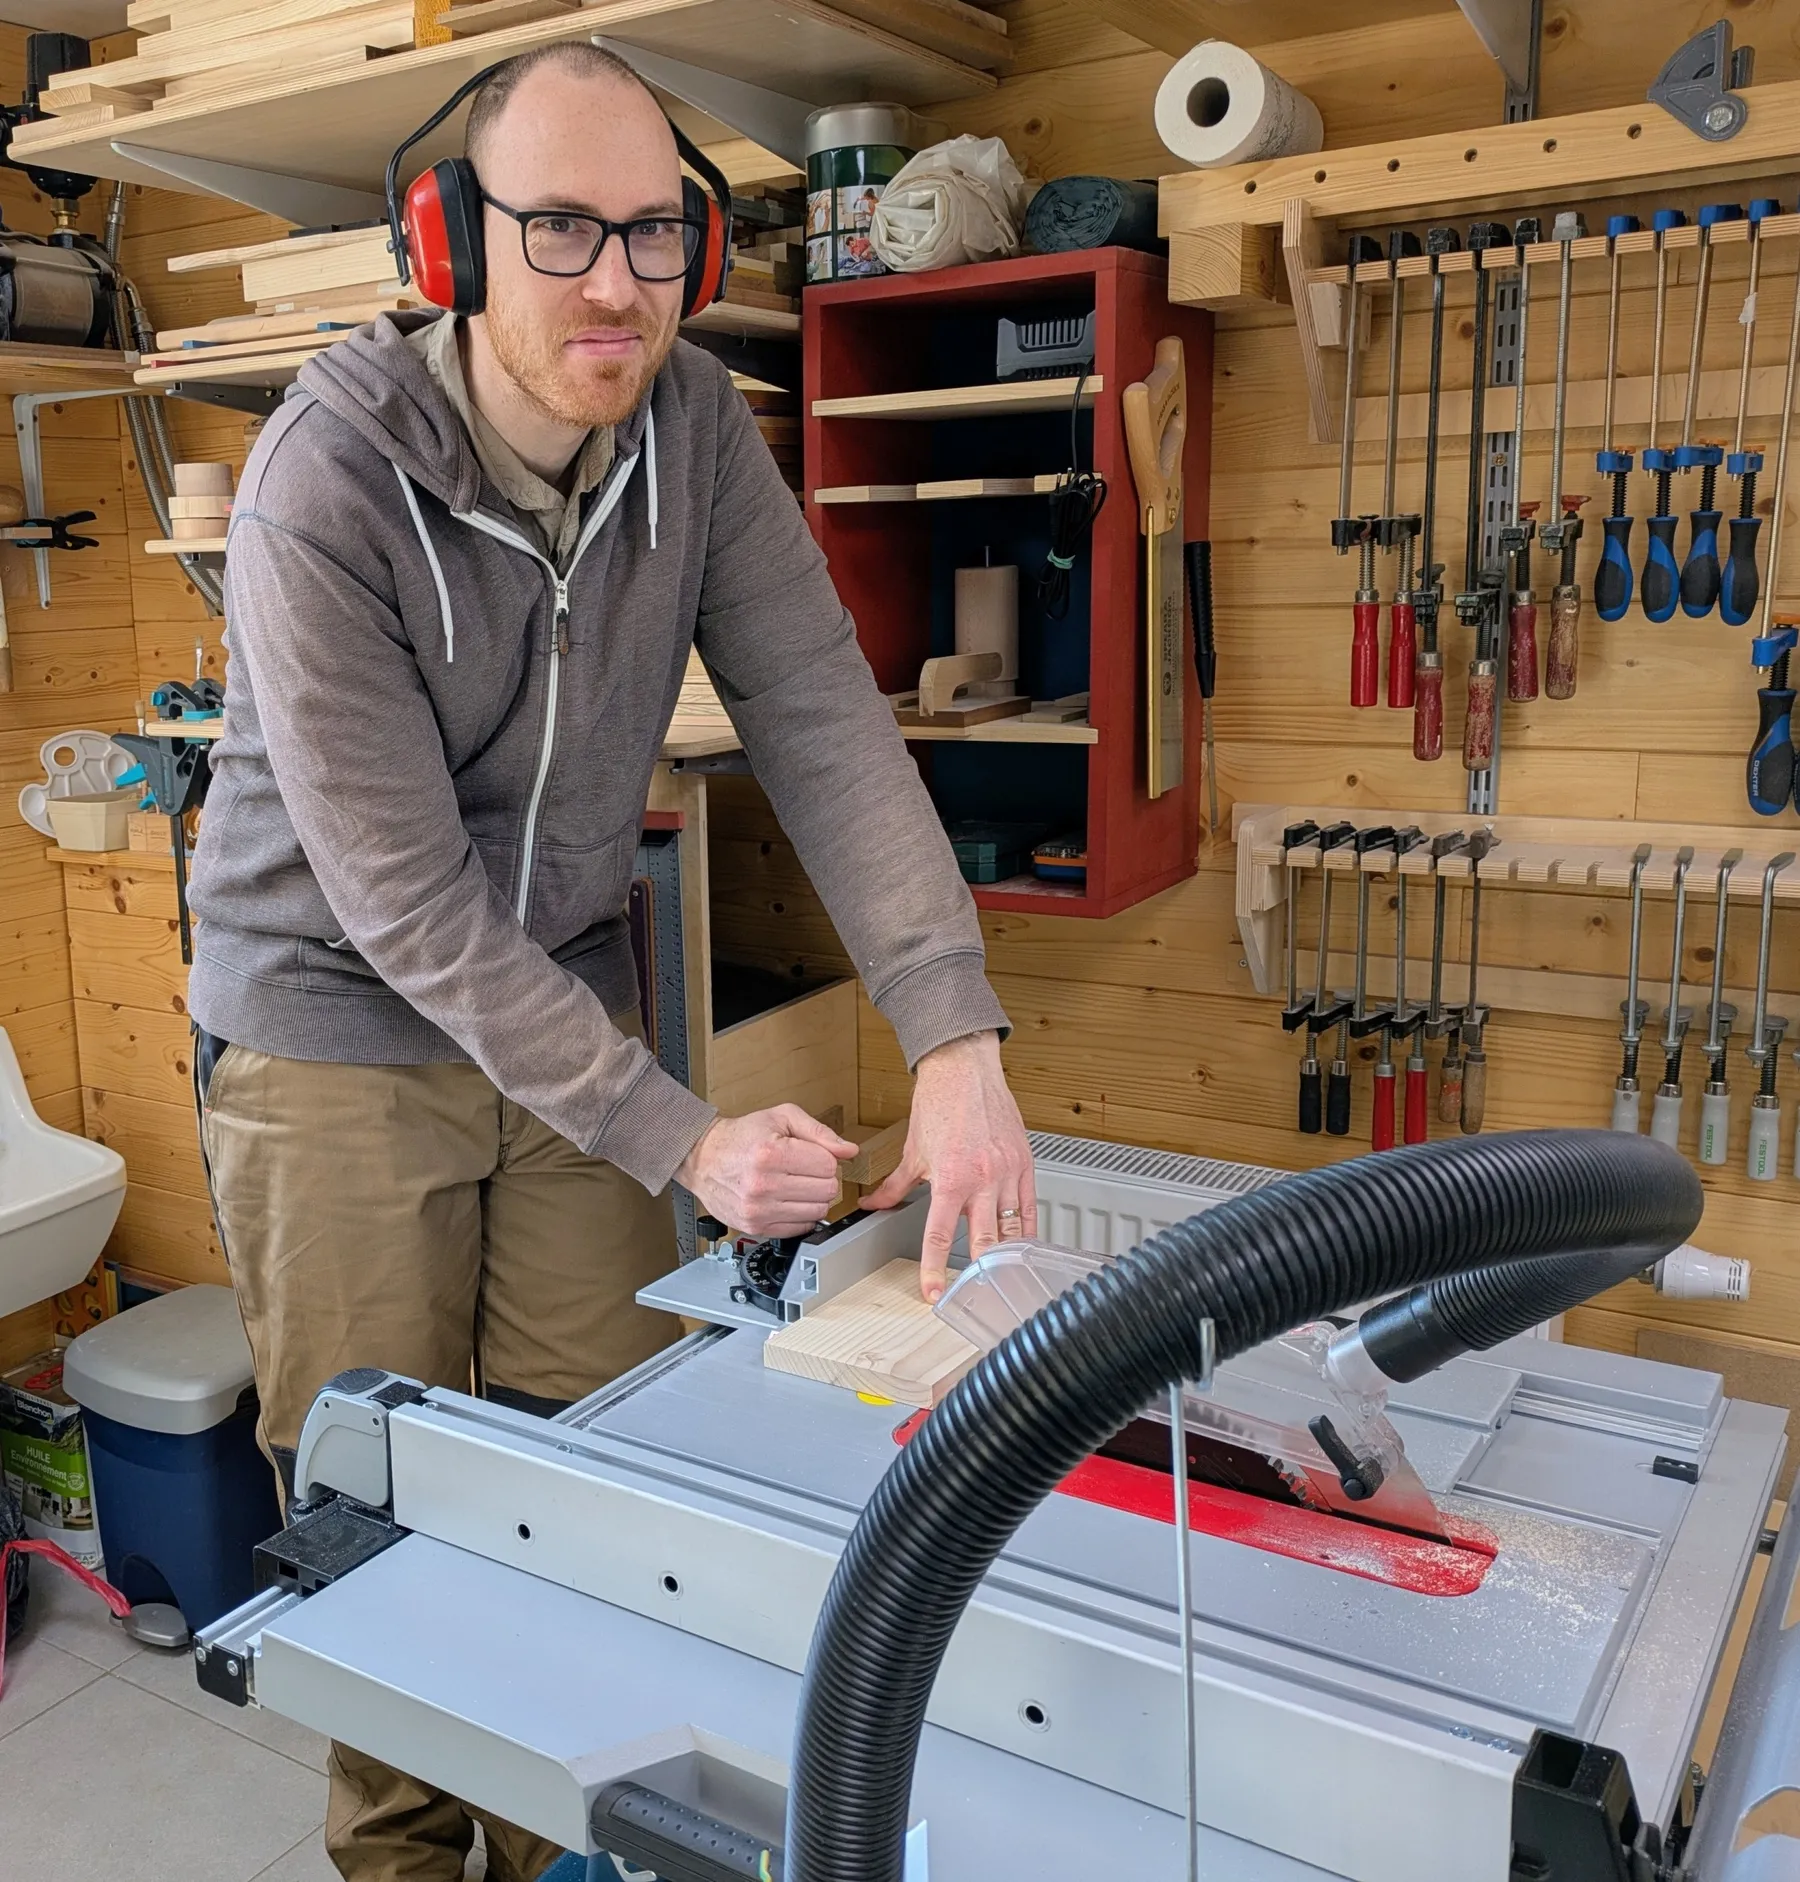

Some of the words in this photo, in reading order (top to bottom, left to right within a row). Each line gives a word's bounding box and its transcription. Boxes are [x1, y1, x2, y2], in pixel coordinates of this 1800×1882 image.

[1752, 760, 1760, 797] DEXTER
[1704, 1124, 1714, 1161] FESTOOL
[1758, 1139, 1767, 1176] FESTOOL
[16, 1399, 52, 1418] Blanchon
[10, 1449, 68, 1481] Environnement
[26, 1446, 51, 1463] HUILE
